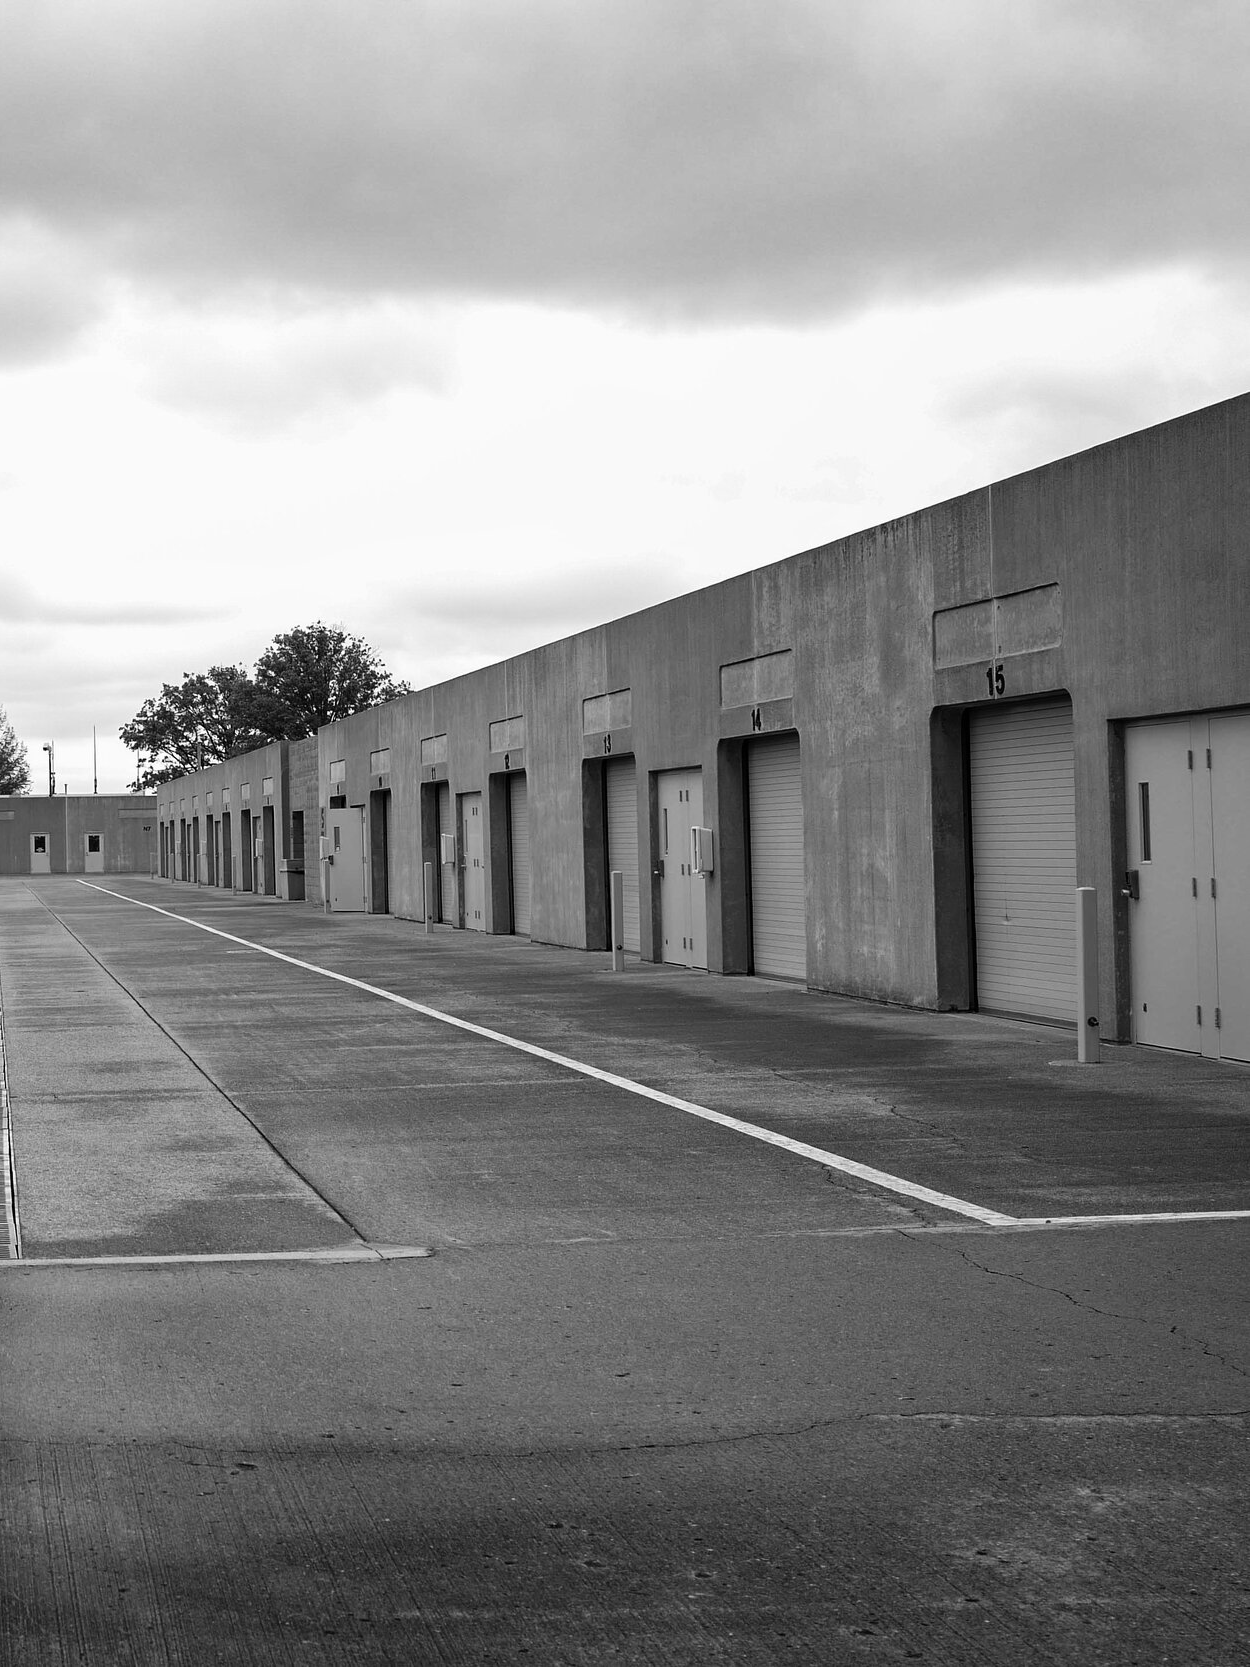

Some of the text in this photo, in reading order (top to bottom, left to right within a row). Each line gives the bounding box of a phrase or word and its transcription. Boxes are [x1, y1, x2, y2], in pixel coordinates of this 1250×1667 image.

[986, 664, 1006, 696] 15
[751, 707, 762, 732] 14
[603, 734, 612, 754] 13
